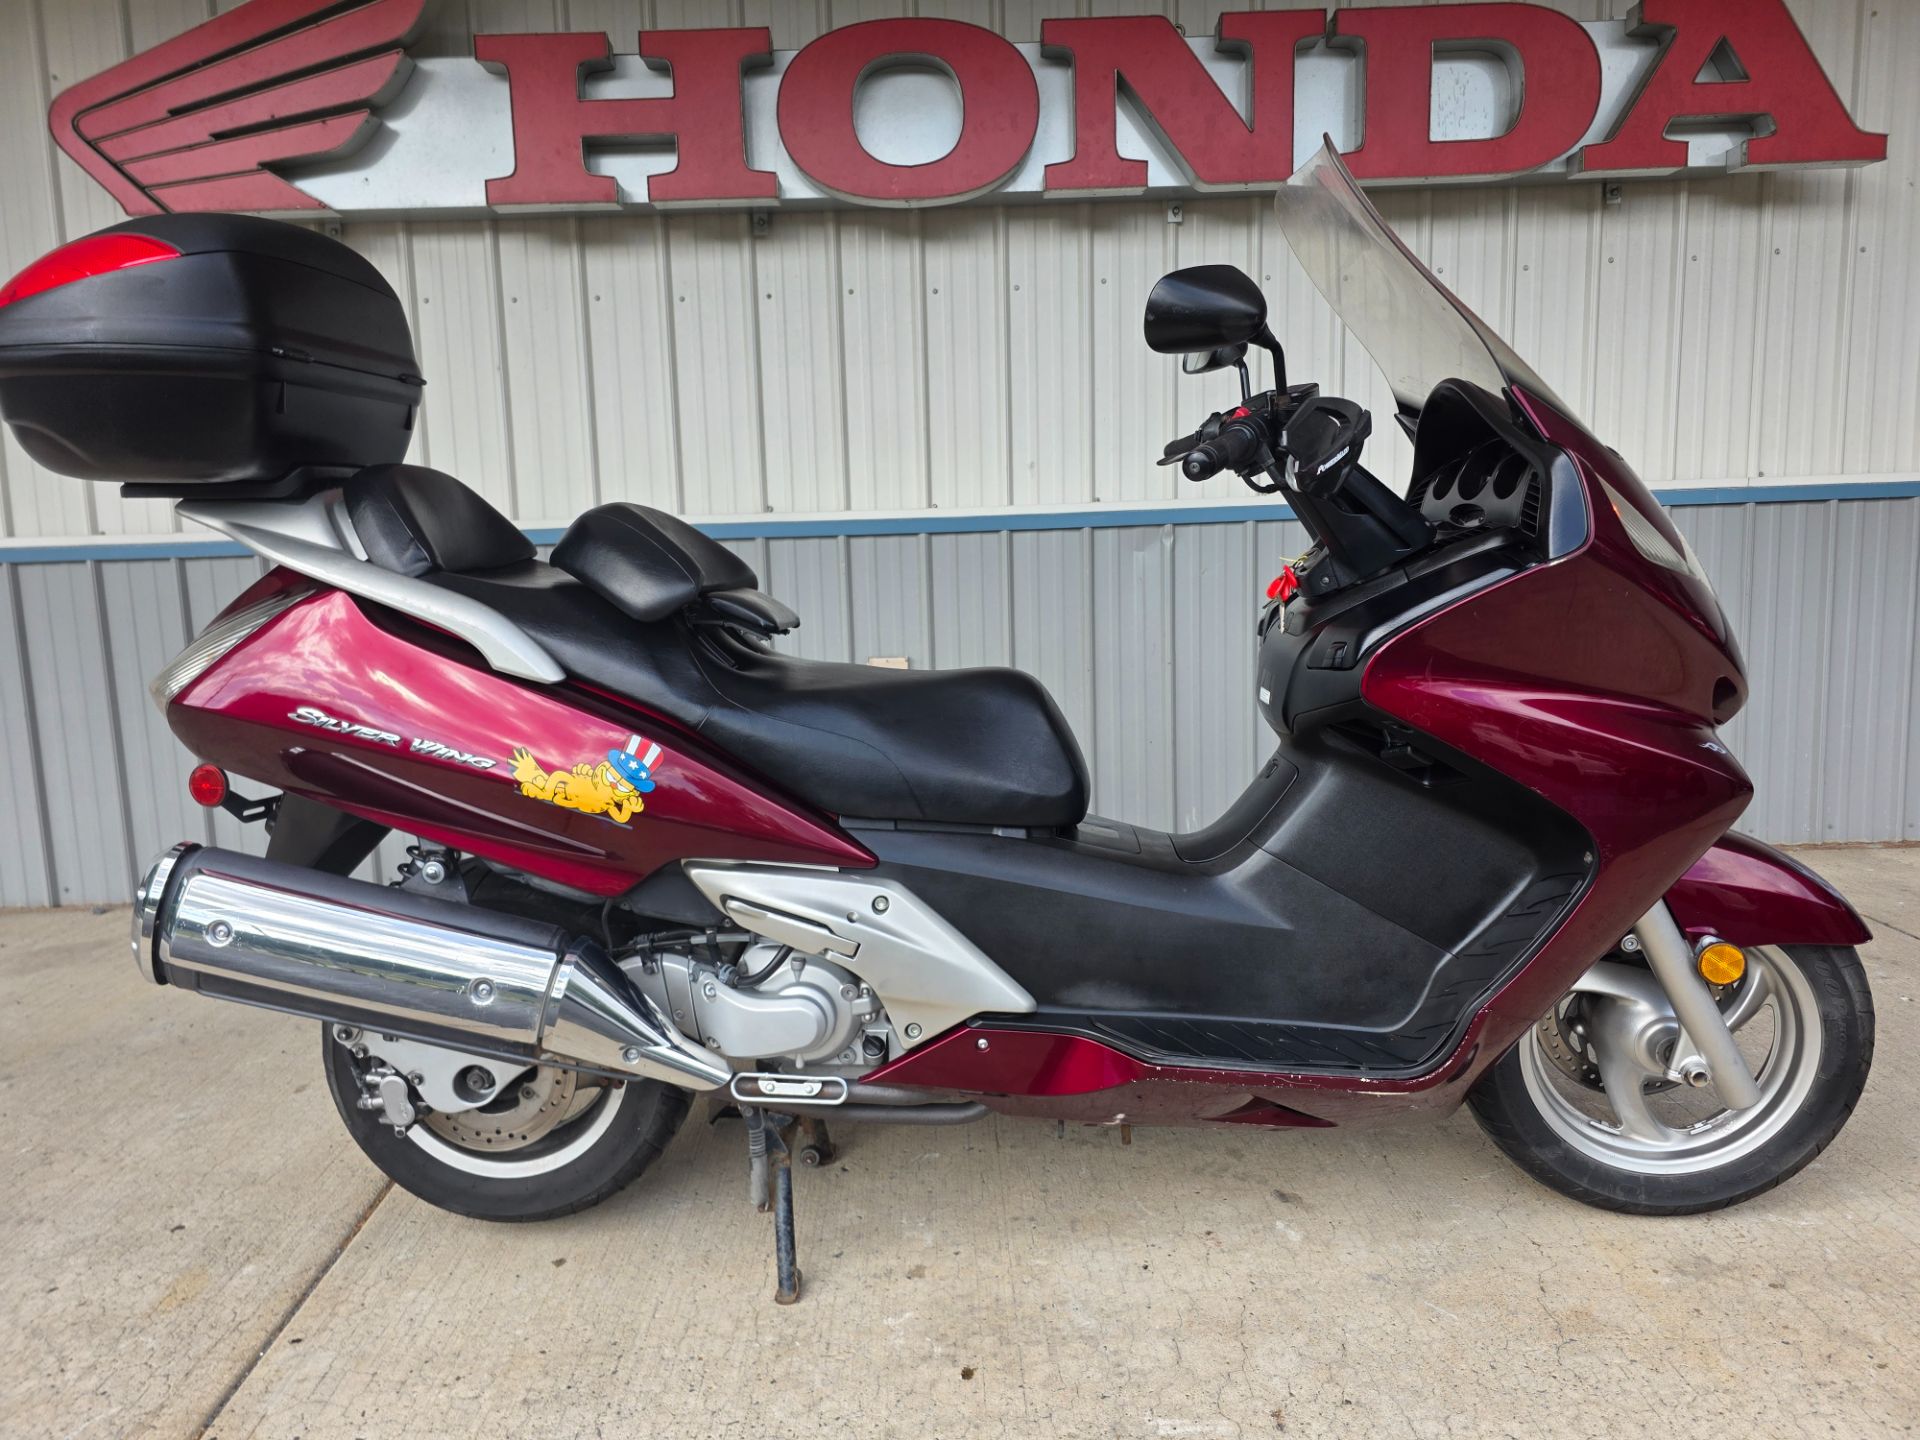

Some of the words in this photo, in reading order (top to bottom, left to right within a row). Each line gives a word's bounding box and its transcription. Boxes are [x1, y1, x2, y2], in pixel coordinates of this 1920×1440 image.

[475, 0, 1888, 208] HONDA
[288, 706, 403, 747] SILVER
[409, 737, 497, 770] WING
